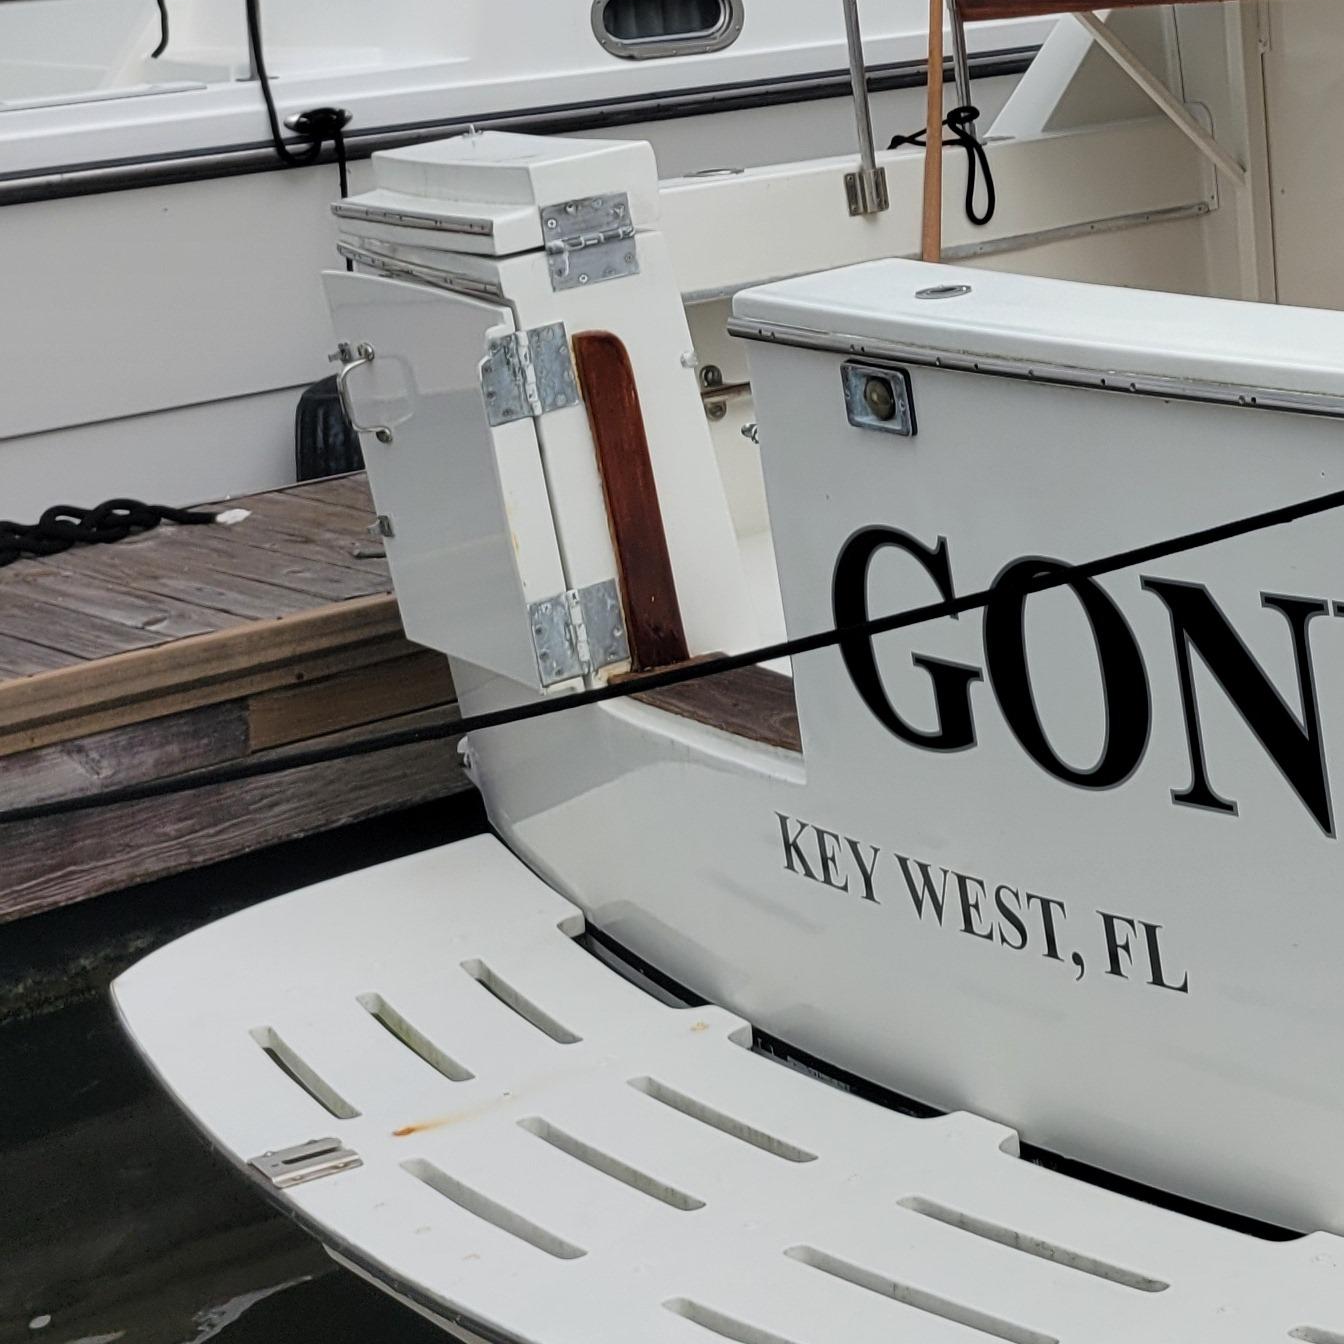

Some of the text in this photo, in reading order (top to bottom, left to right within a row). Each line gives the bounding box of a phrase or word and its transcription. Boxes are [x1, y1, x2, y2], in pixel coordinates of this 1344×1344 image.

[774, 811, 1190, 994] KEY WEST, FL
